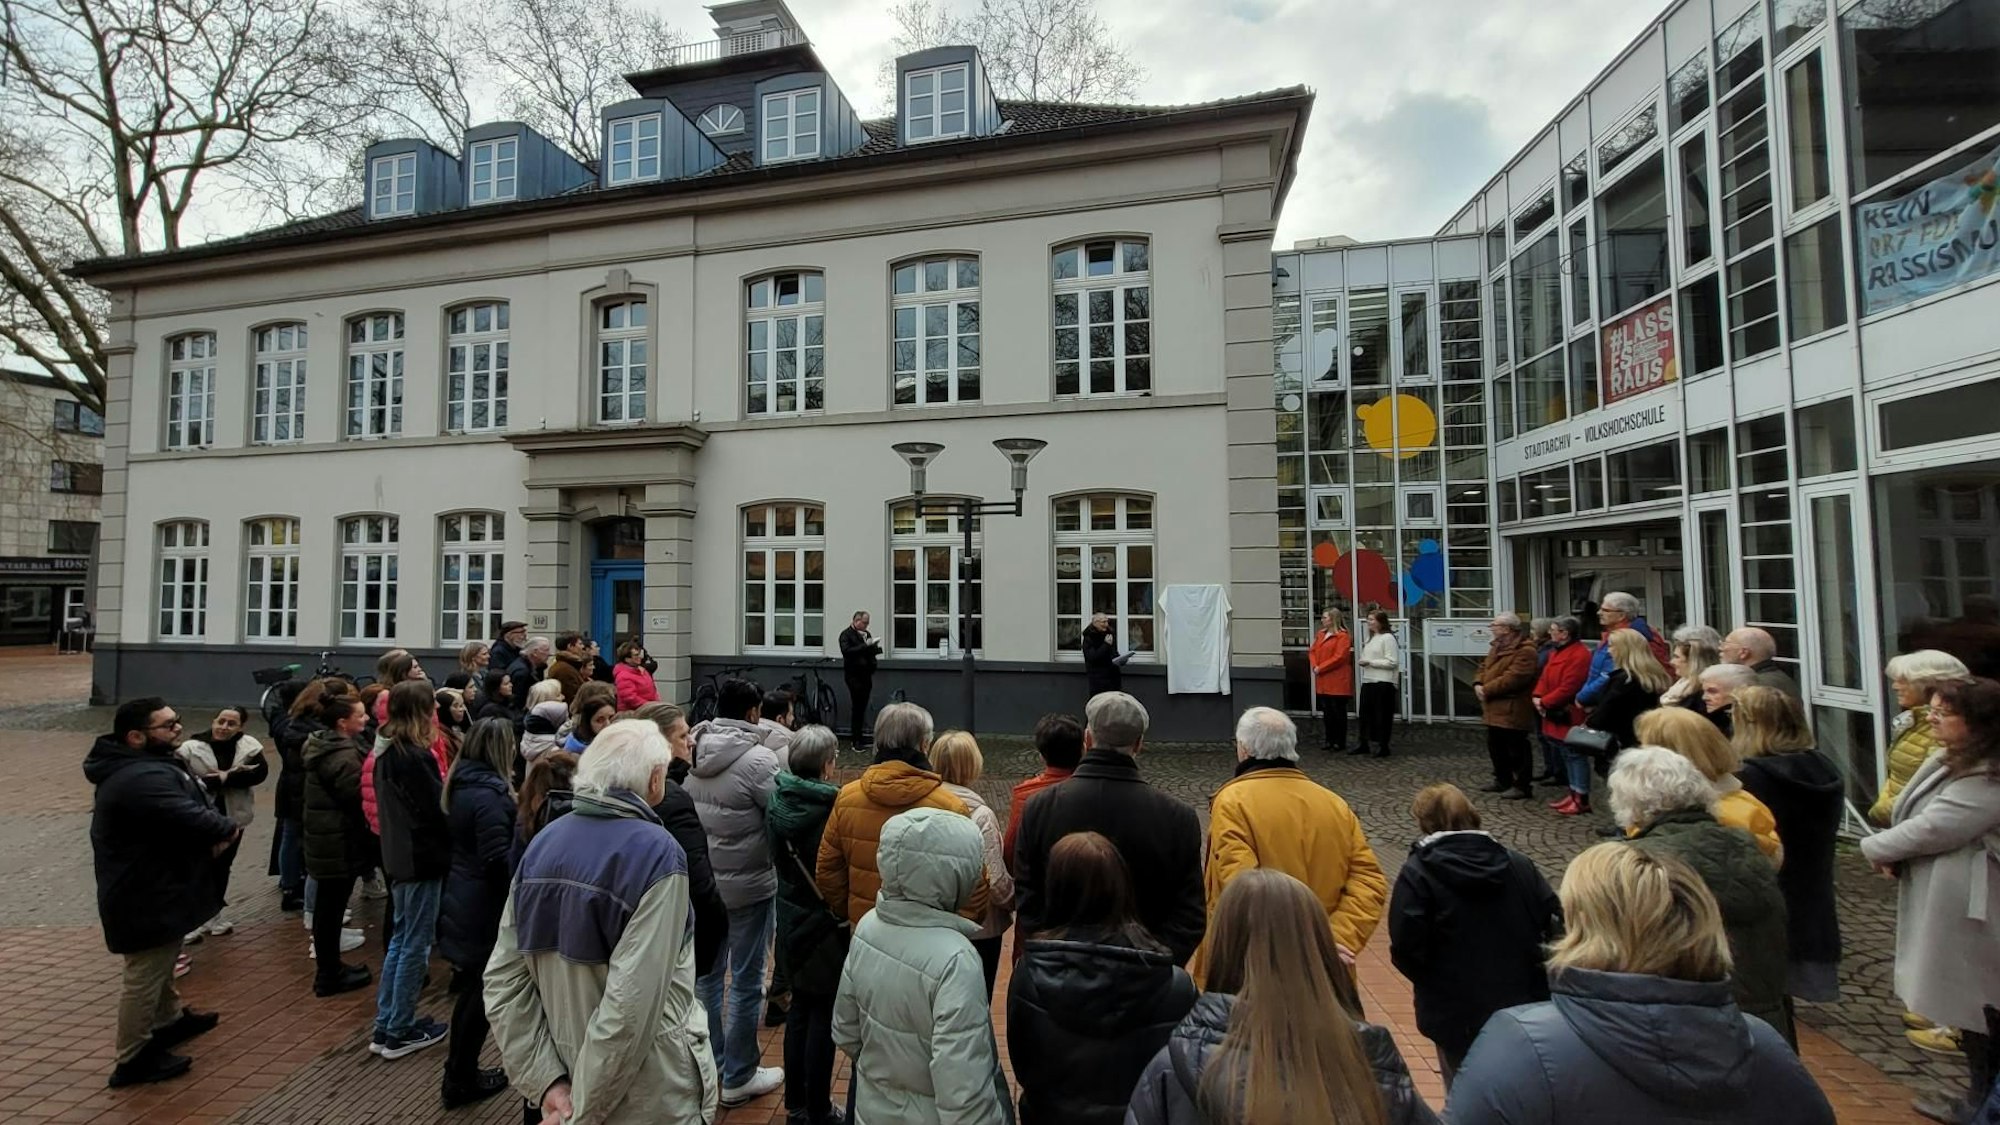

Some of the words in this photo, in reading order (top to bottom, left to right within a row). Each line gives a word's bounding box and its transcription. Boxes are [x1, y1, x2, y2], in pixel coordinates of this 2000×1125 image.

[1864, 190, 1930, 229] KEIN
[1609, 305, 1673, 355] #LASS
[1610, 357, 1663, 396] RAUS
[1524, 433, 1571, 460] STADTARCHIV
[1584, 404, 1665, 443] VOLKSHOCHSCHULE
